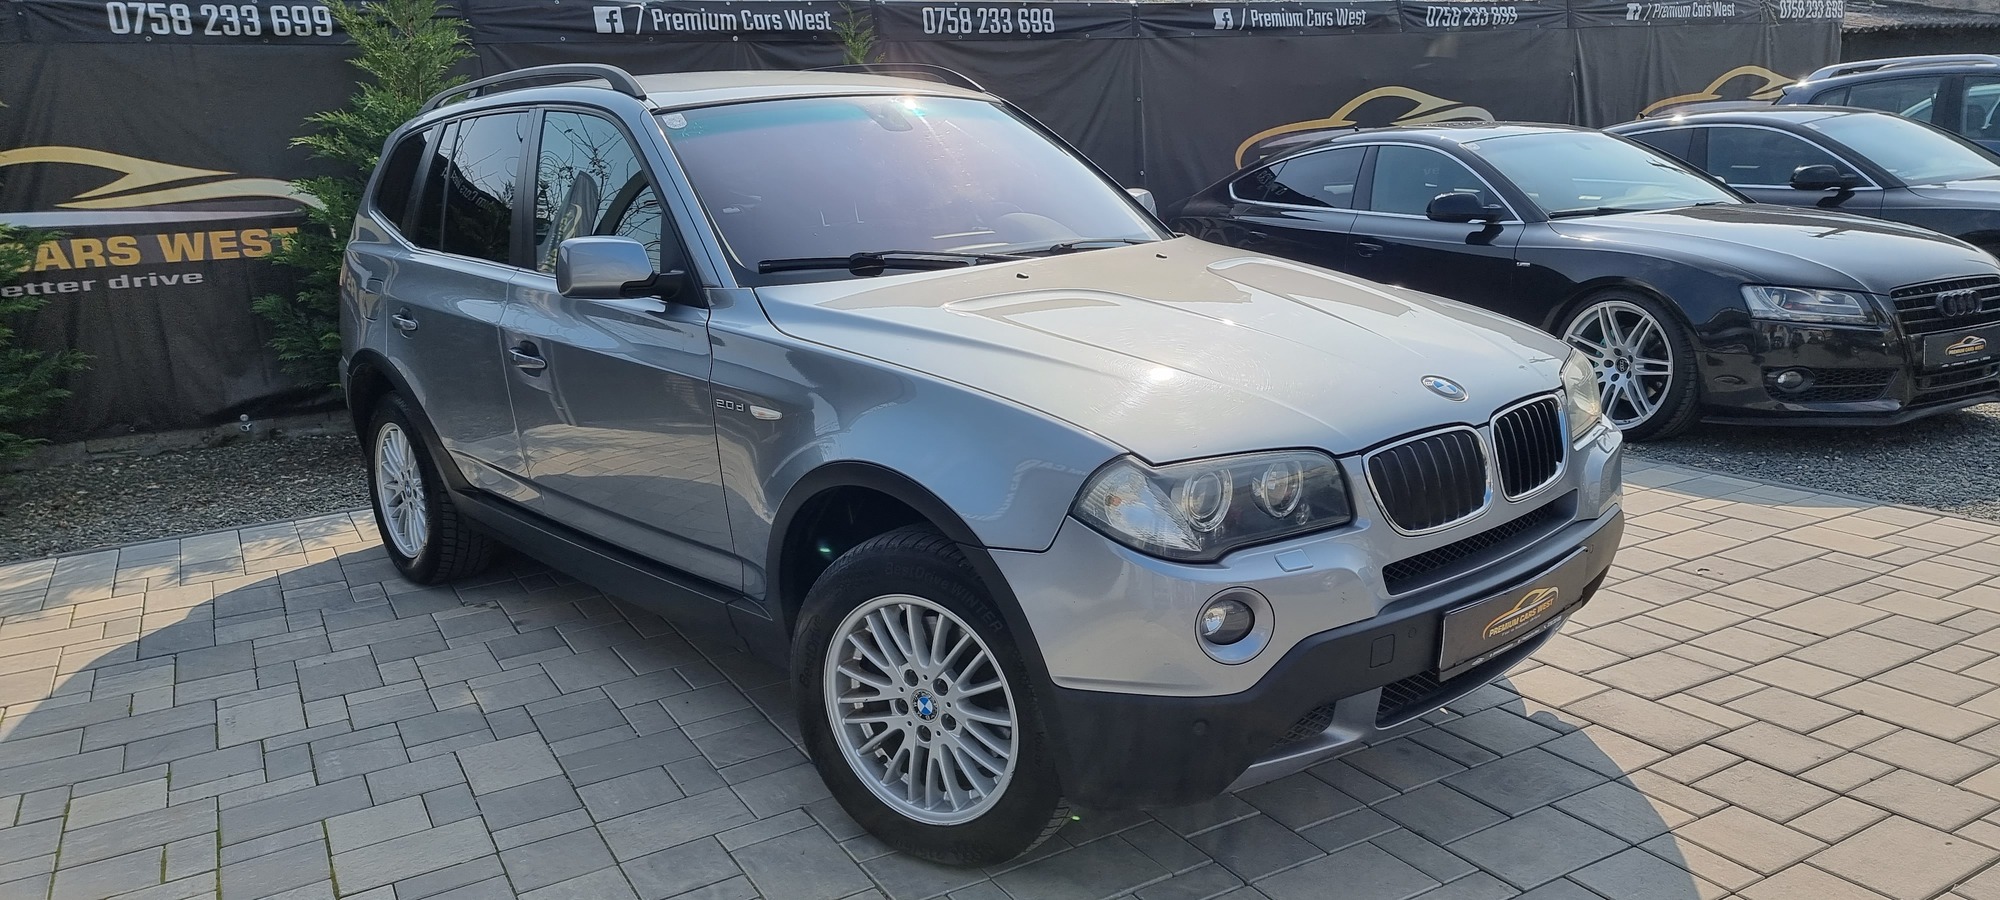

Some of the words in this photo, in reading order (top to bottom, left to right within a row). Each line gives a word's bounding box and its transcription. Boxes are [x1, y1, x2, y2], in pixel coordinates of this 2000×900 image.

[106, 2, 193, 35] 0758
[200, 4, 262, 36] 233
[270, 5, 333, 36] 699
[651, 8, 738, 31] Premium
[741, 9, 783, 31] Cars
[784, 9, 832, 31] West
[922, 7, 972, 34] 0758
[976, 7, 1013, 34] 233
[1018, 7, 1055, 34] 699
[1250, 8, 1304, 28] Premium
[1306, 8, 1334, 27] Cars
[1335, 8, 1367, 27] West
[1426, 6, 1461, 27] 0758
[1652, 2, 1691, 18] Premium
[1692, 2, 1711, 18] Cars
[1713, 1, 1736, 17] West
[1780, 0, 1805, 19] 0758
[1805, 0, 1824, 18] 233
[1, 280, 96, 297] etter
[108, 272, 204, 290] drive
[952, 582, 1003, 632] WINTER
